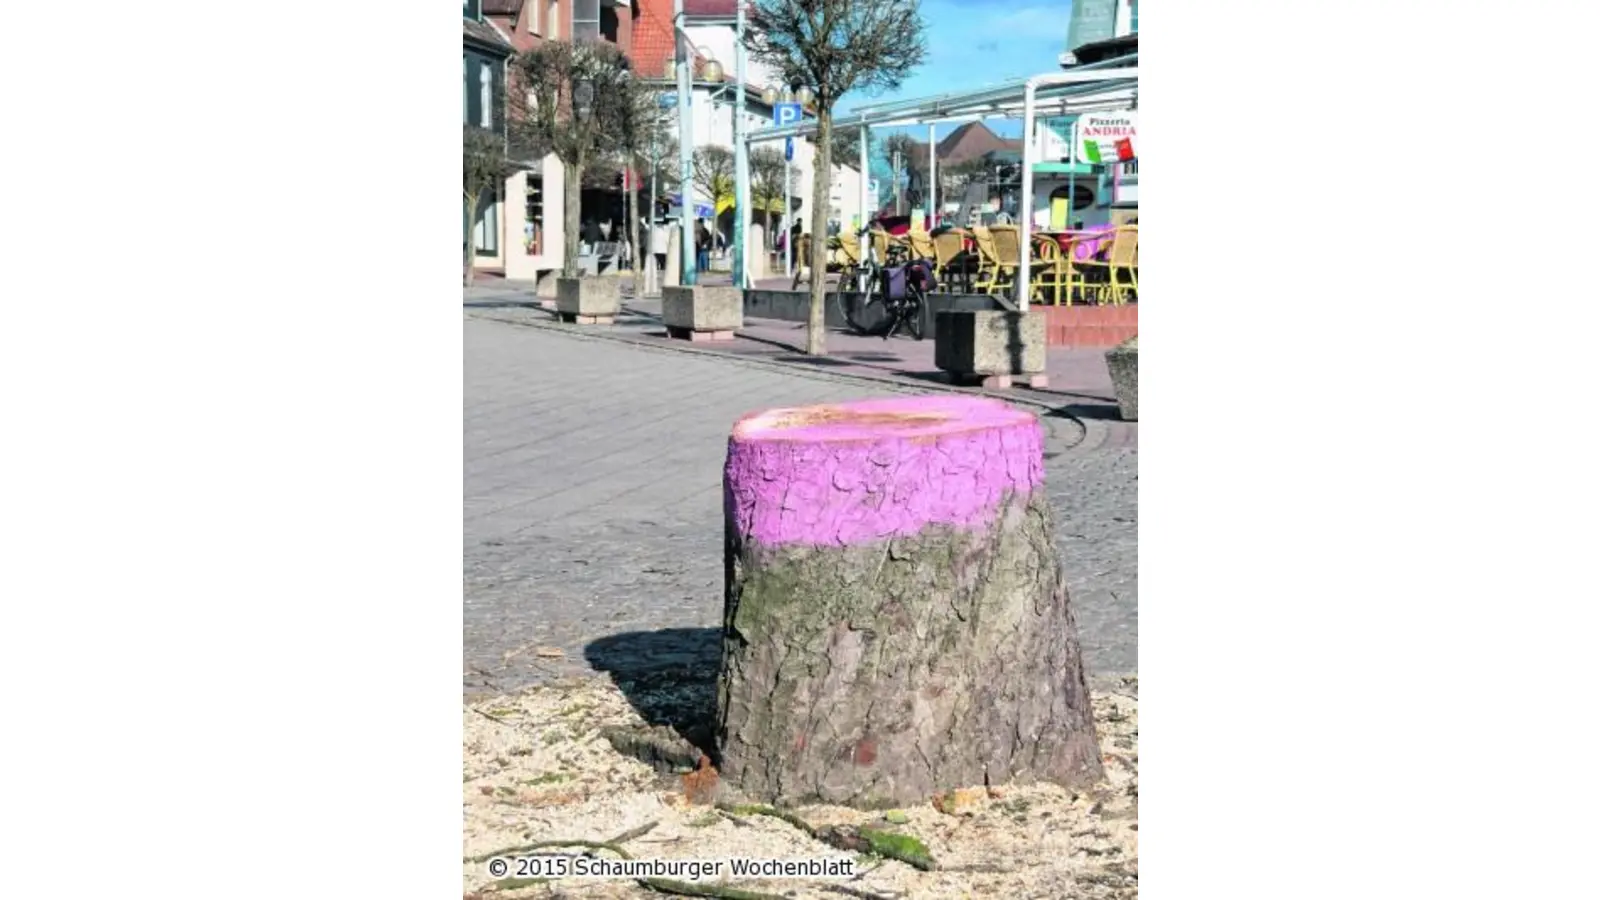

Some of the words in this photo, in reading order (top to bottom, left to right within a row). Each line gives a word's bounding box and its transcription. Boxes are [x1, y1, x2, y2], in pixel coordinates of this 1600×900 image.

[779, 107, 796, 125] P
[1089, 117, 1131, 126] Pizzeria
[1083, 126, 1137, 136] ANDRIA
